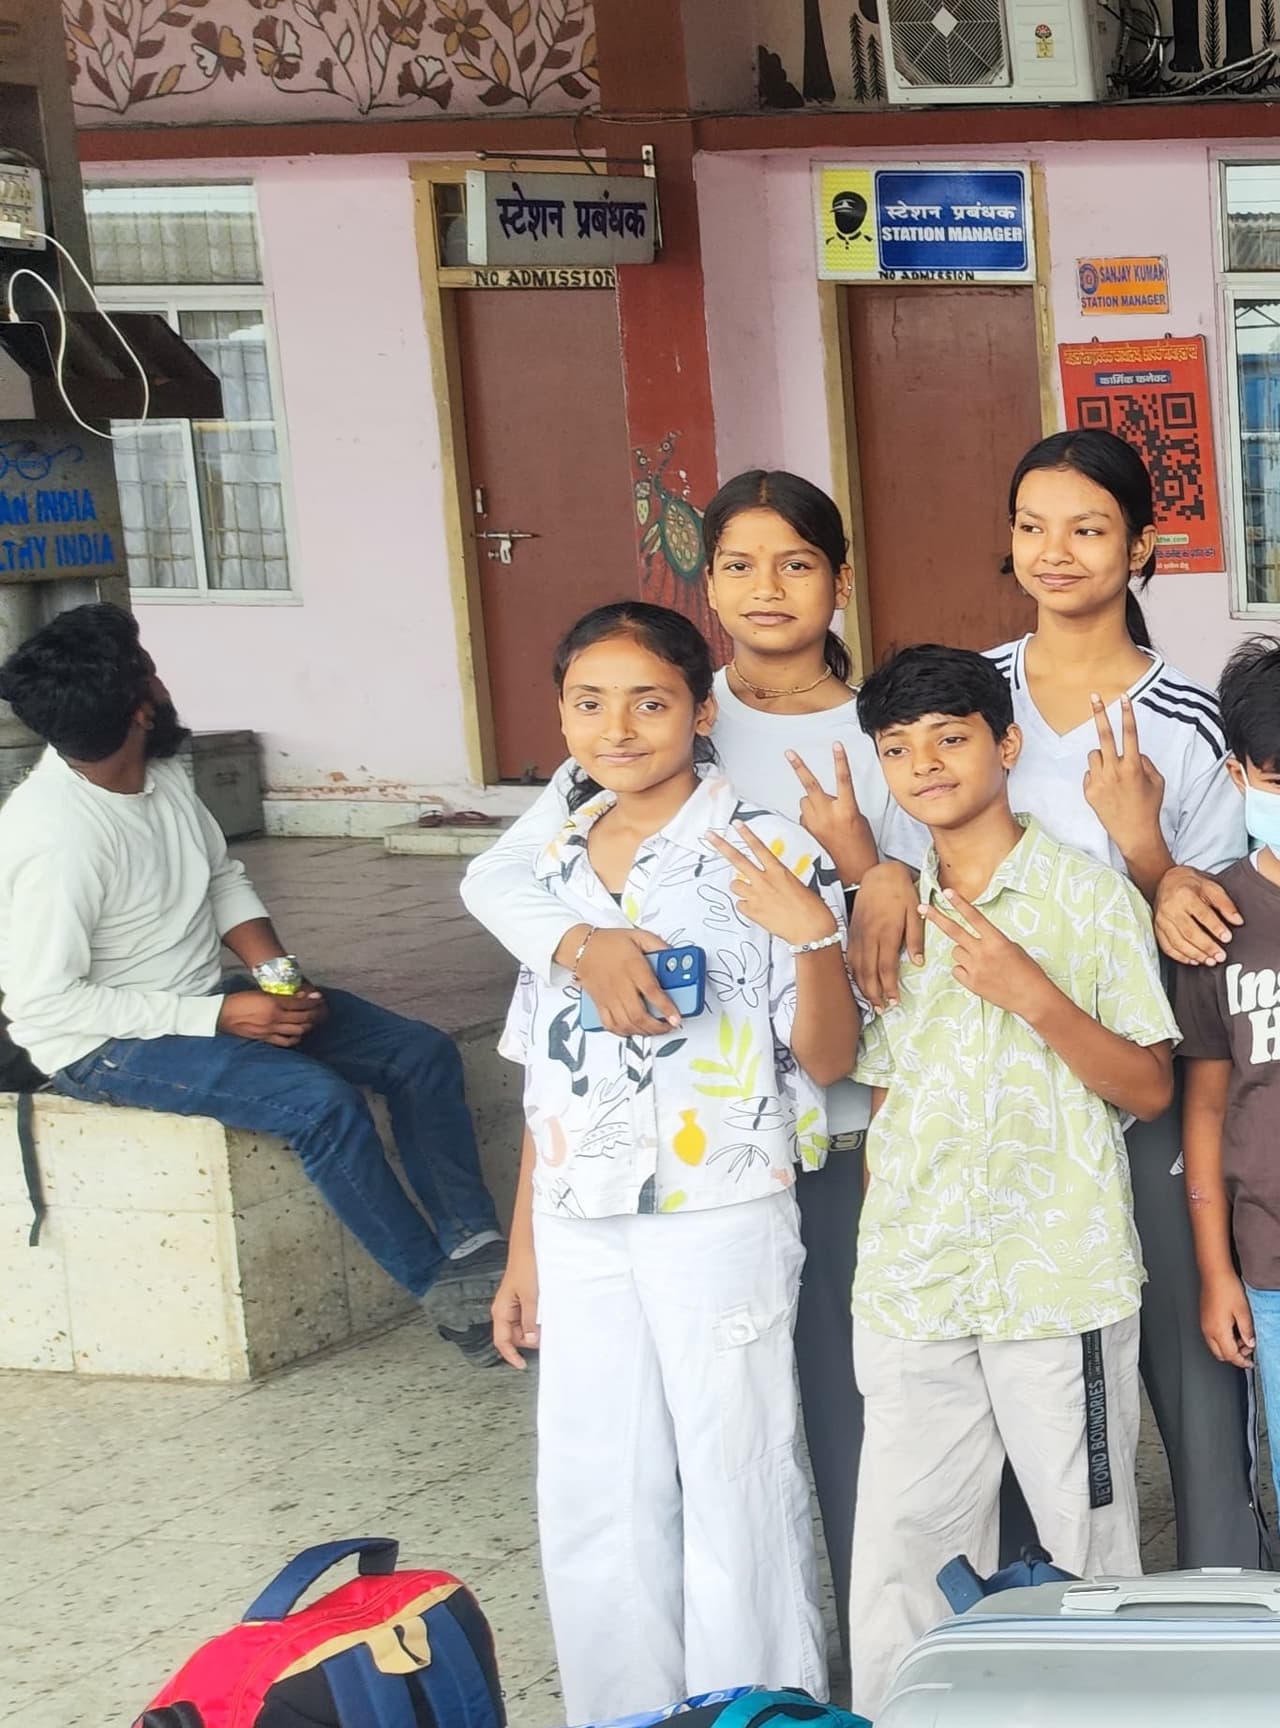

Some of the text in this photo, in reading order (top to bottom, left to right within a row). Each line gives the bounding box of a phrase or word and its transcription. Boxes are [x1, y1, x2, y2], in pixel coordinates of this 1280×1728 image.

[496, 182, 649, 242] स्टेशन प्रबंधक
[884, 200, 1017, 221] स्टेशन प्रबंधक
[881, 226, 1024, 242] STATION MANAGER
[475, 269, 616, 287] NO ADMISSION
[878, 270, 975, 281] NO ADMISSION
[1100, 263, 1166, 284] SANJAY KUMAR
[1081, 293, 1166, 309] STATION MANAGER
[36, 488, 98, 523] INDIA
[55, 532, 116, 567] INDIA
[1087, 1379, 1107, 1451] BOUNDRIES
